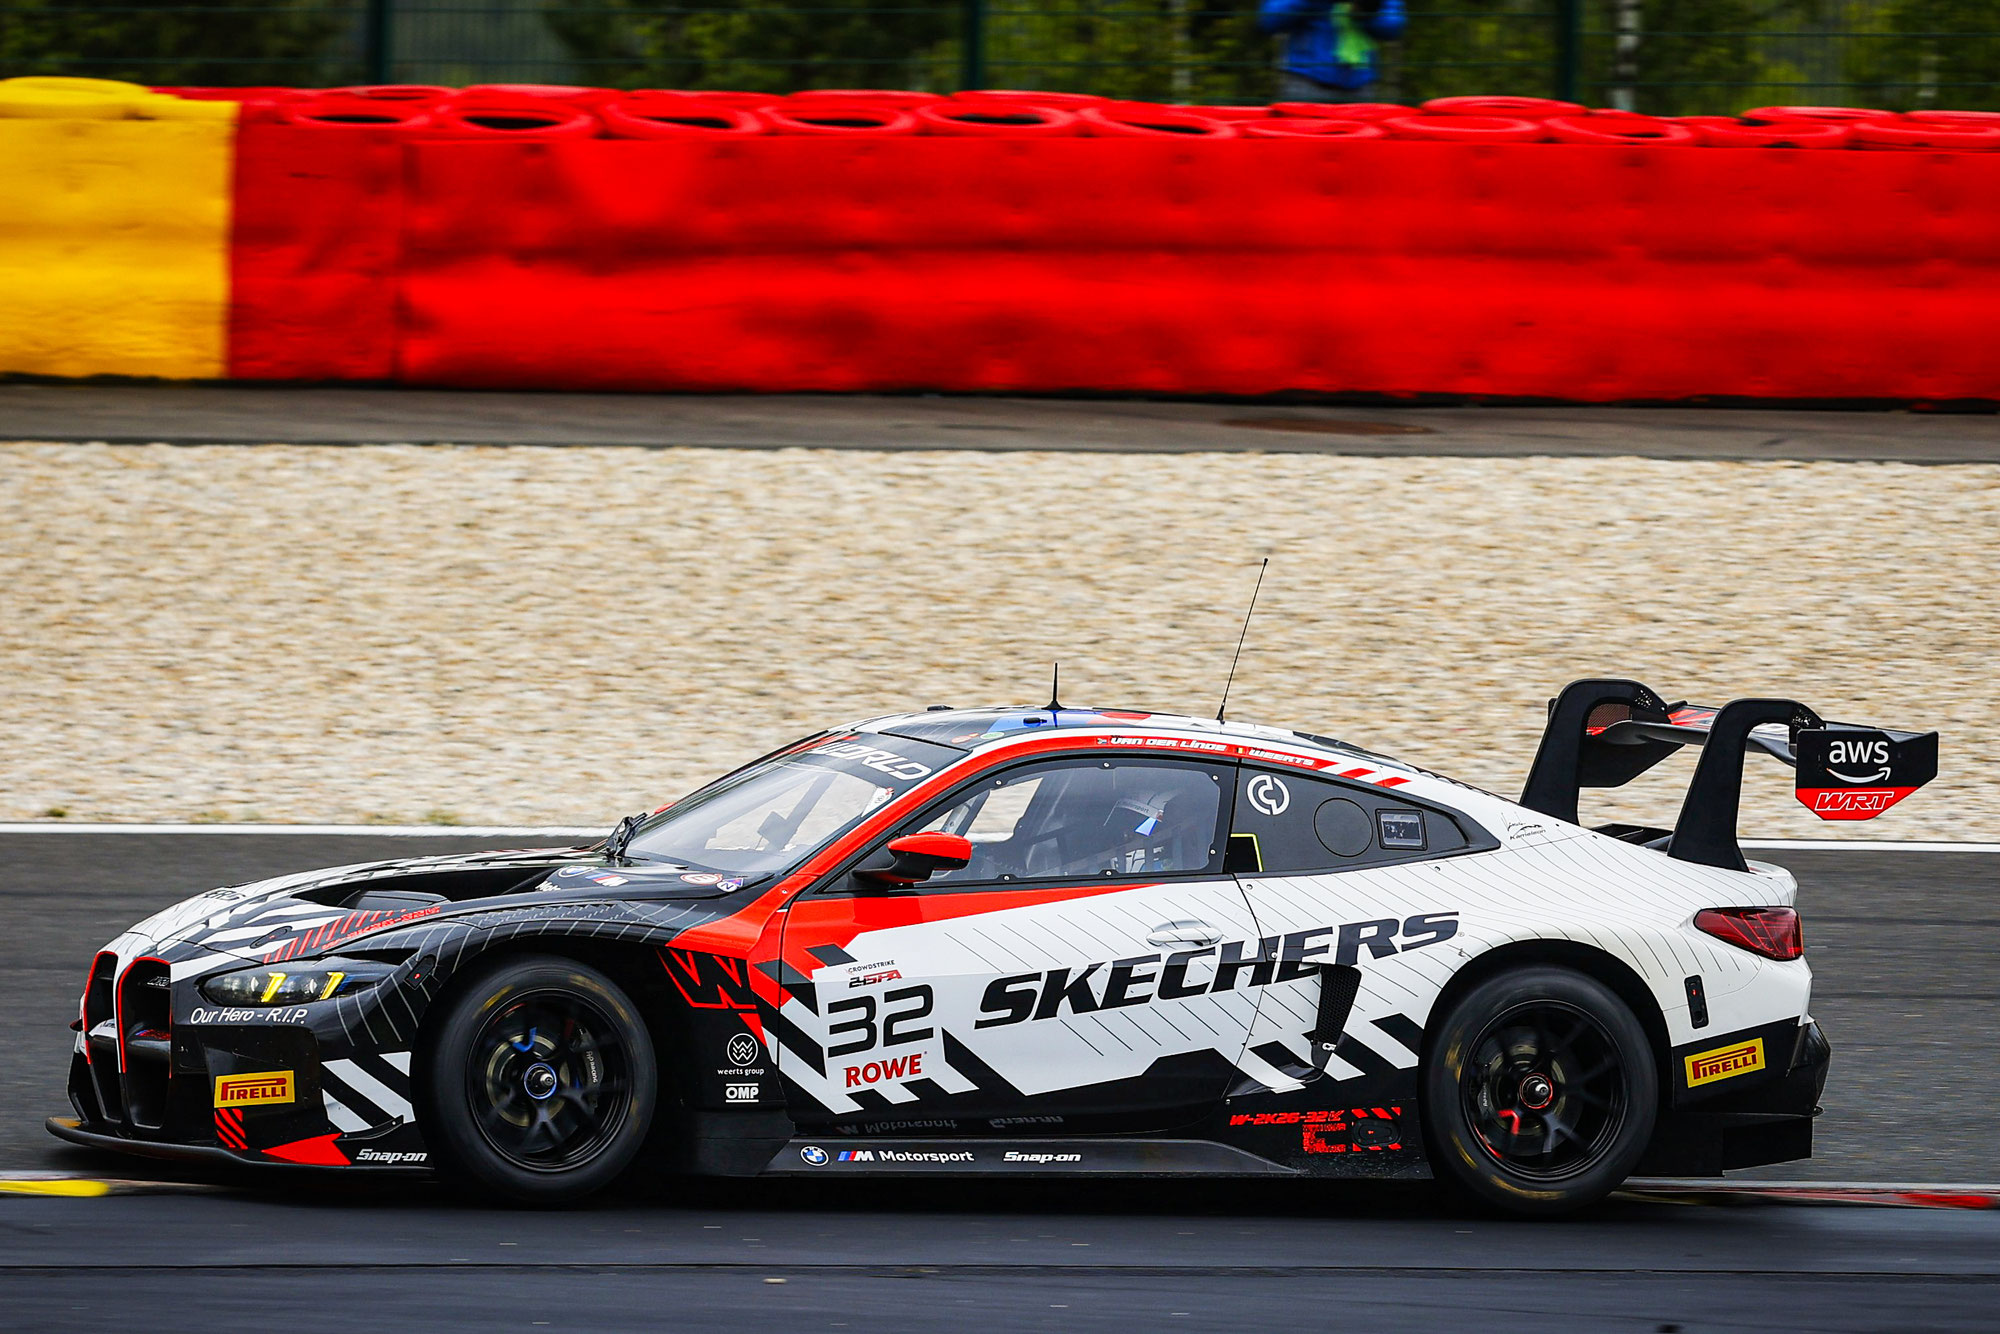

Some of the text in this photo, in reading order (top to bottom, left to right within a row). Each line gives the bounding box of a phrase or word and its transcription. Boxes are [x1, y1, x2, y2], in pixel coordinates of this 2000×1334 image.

[808, 742, 932, 781] WORLD
[1248, 749, 1315, 766] WEERTS
[1829, 740, 1889, 764] aws
[1815, 791, 1895, 811] WRT
[848, 960, 896, 972] CROWDSTRIKE
[974, 911, 1460, 1030] SKECHERS
[190, 1007, 219, 1024] Our
[218, 1007, 255, 1022] Hero
[265, 1008, 308, 1025] R.I.P.
[828, 984, 935, 1059] 32
[744, 1068, 765, 1077] group
[844, 1053, 923, 1089] ROWE
[1692, 1046, 1757, 1080] PIRELLI
[220, 1077, 288, 1101] PIRELLI
[725, 1086, 760, 1099] OMP
[356, 1149, 428, 1164] Snap-on
[879, 1150, 975, 1163] Motorsport
[1003, 1151, 1082, 1163] Snap-on
